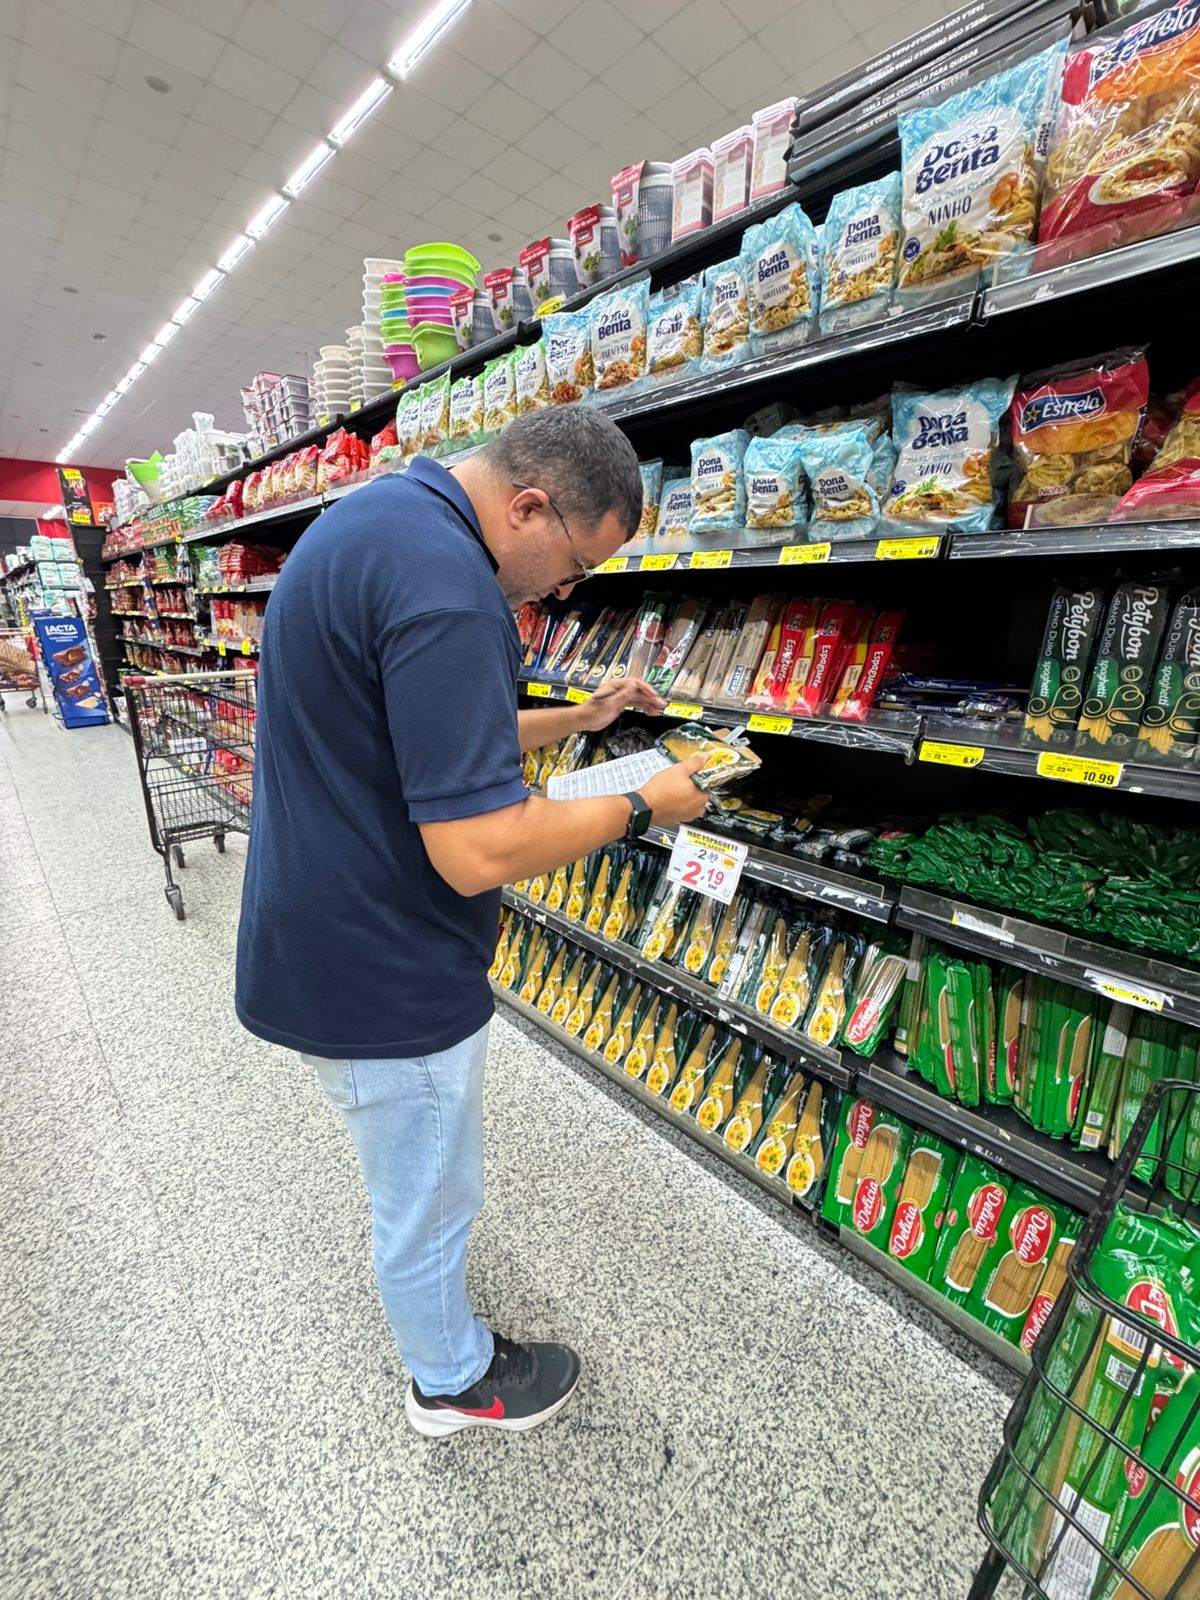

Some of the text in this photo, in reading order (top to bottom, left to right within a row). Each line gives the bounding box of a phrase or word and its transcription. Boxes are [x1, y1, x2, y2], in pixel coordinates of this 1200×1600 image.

[945, 16, 961, 31] CON
[862, 99, 881, 114] TABLA
[882, 92, 896, 106] CON
[929, 65, 949, 80] PARA
[949, 48, 979, 69] QUESOS
[1100, 144, 1135, 165] Ninho
[916, 144, 1000, 194] Benta
[928, 195, 972, 226] NINHO
[844, 224, 882, 248] Benta
[847, 214, 879, 235] Dona
[757, 258, 790, 283] Benta
[758, 250, 787, 271] Dona
[598, 319, 632, 341] Benta
[1041, 395, 1102, 419] Estrela
[918, 411, 967, 432] Dona
[911, 427, 969, 450] Benta
[697, 464, 723, 477] Benta
[699, 456, 721, 469] Dona
[751, 484, 778, 494] Benta
[819, 475, 845, 487] Dona
[820, 483, 849, 496] Benta
[1038, 484, 1067, 496] Ninho
[45, 624, 79, 637] LACTA
[1045, 595, 1065, 657] GRANO DURO
[1063, 591, 1095, 661] Petybon
[1102, 592, 1124, 656] GRANO DURO
[1122, 587, 1159, 661] Petybon
[1165, 632, 1181, 661] DURO
[812, 644, 832, 688] Espaguete
[863, 651, 884, 694] Espaguete
[1040, 660, 1052, 698] spaghetti
[1096, 660, 1109, 698] spaghetti
[1158, 665, 1173, 707] spaghetti
[1083, 771, 1115, 785] 10,99
